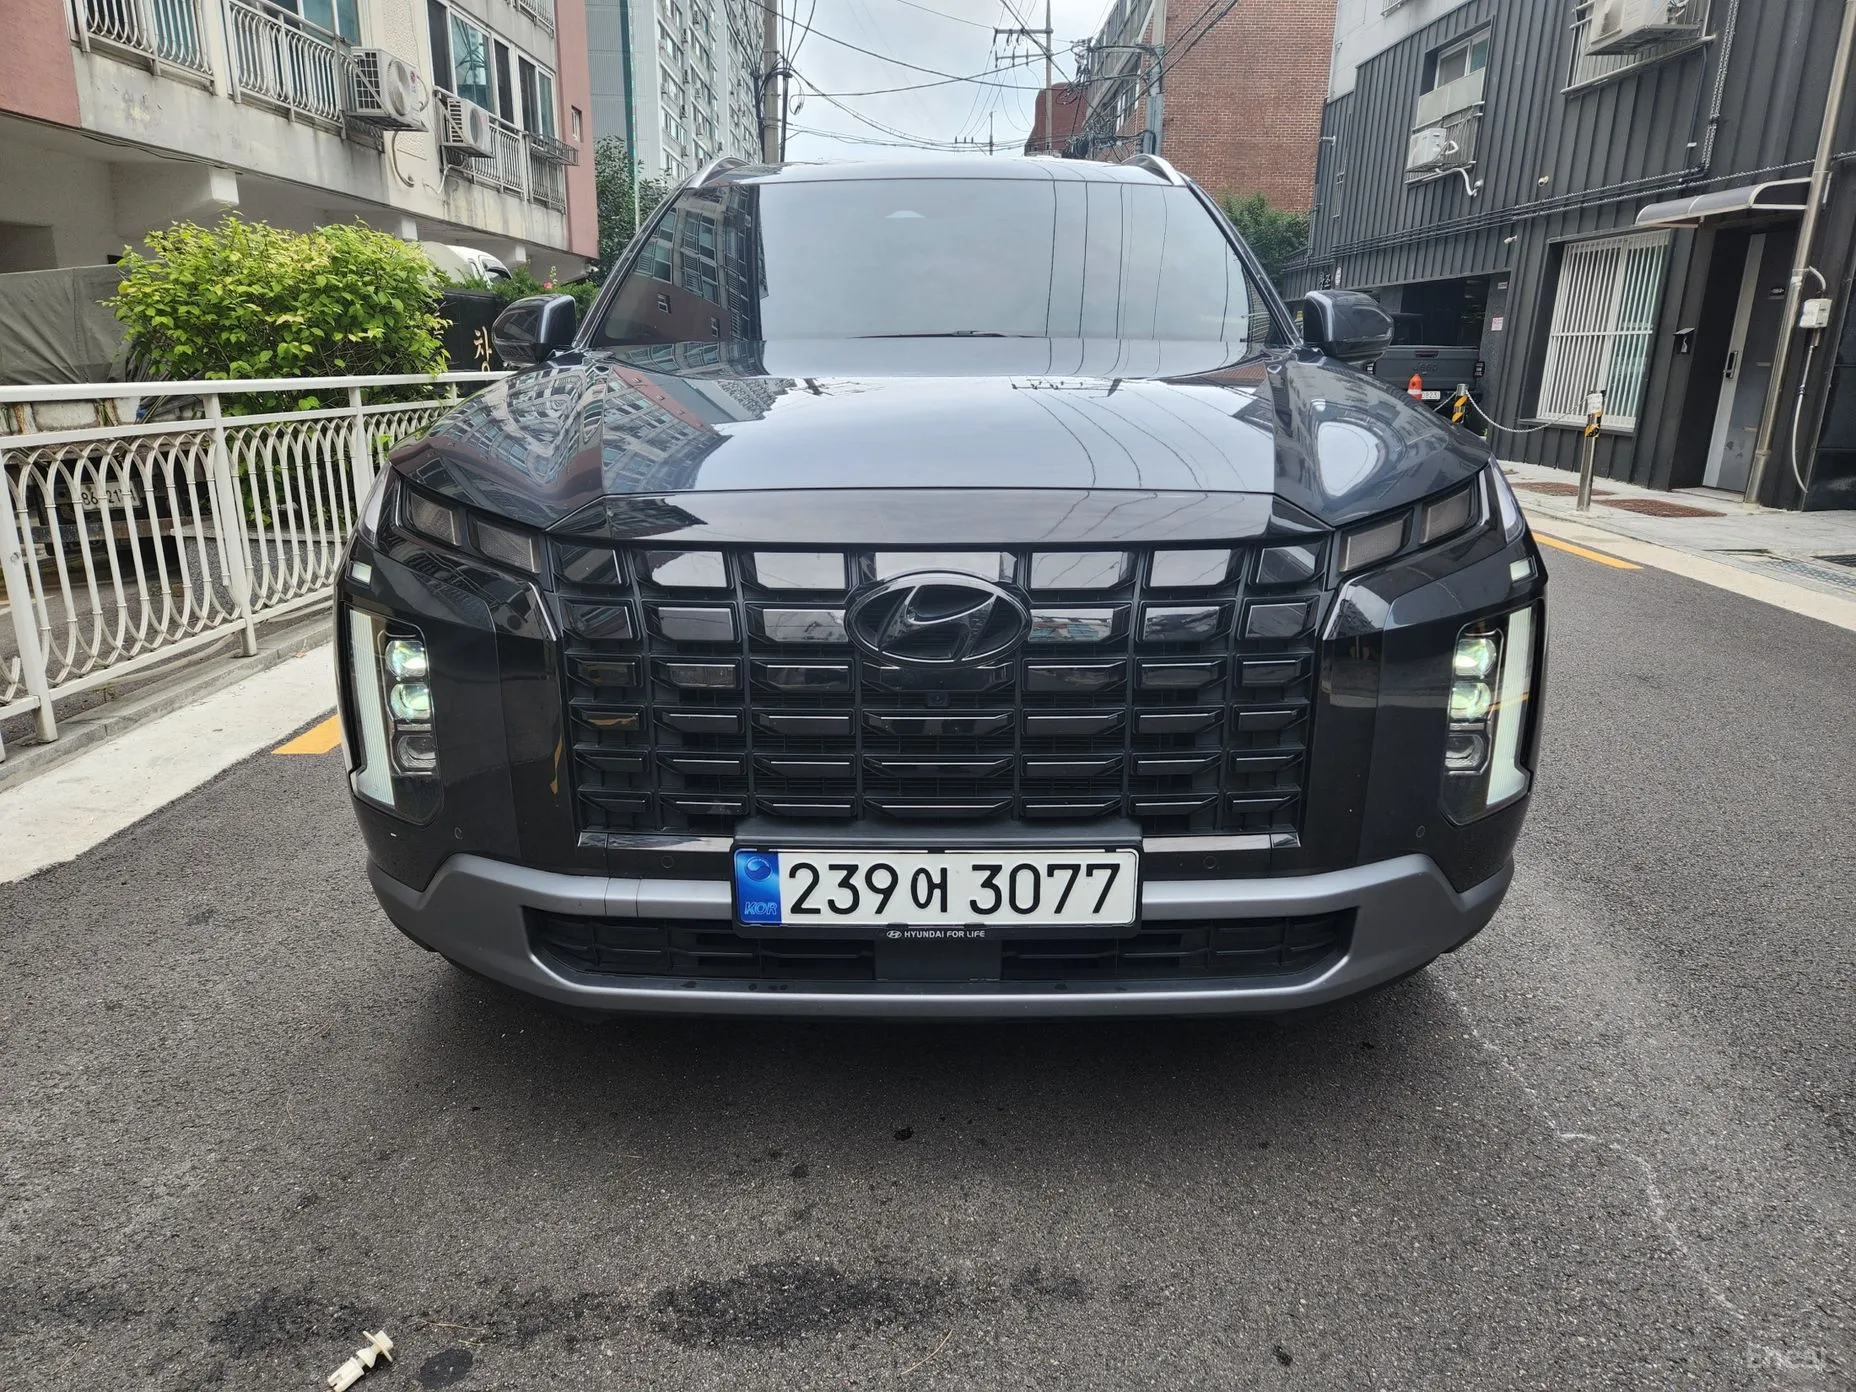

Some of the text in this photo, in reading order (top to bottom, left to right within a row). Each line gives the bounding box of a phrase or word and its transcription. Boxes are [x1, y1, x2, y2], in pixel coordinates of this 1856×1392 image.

[969, 863, 1121, 915] 3077
[744, 901, 778, 916] KOR
[904, 930, 986, 938] HYUNDAI FOR LIFE
